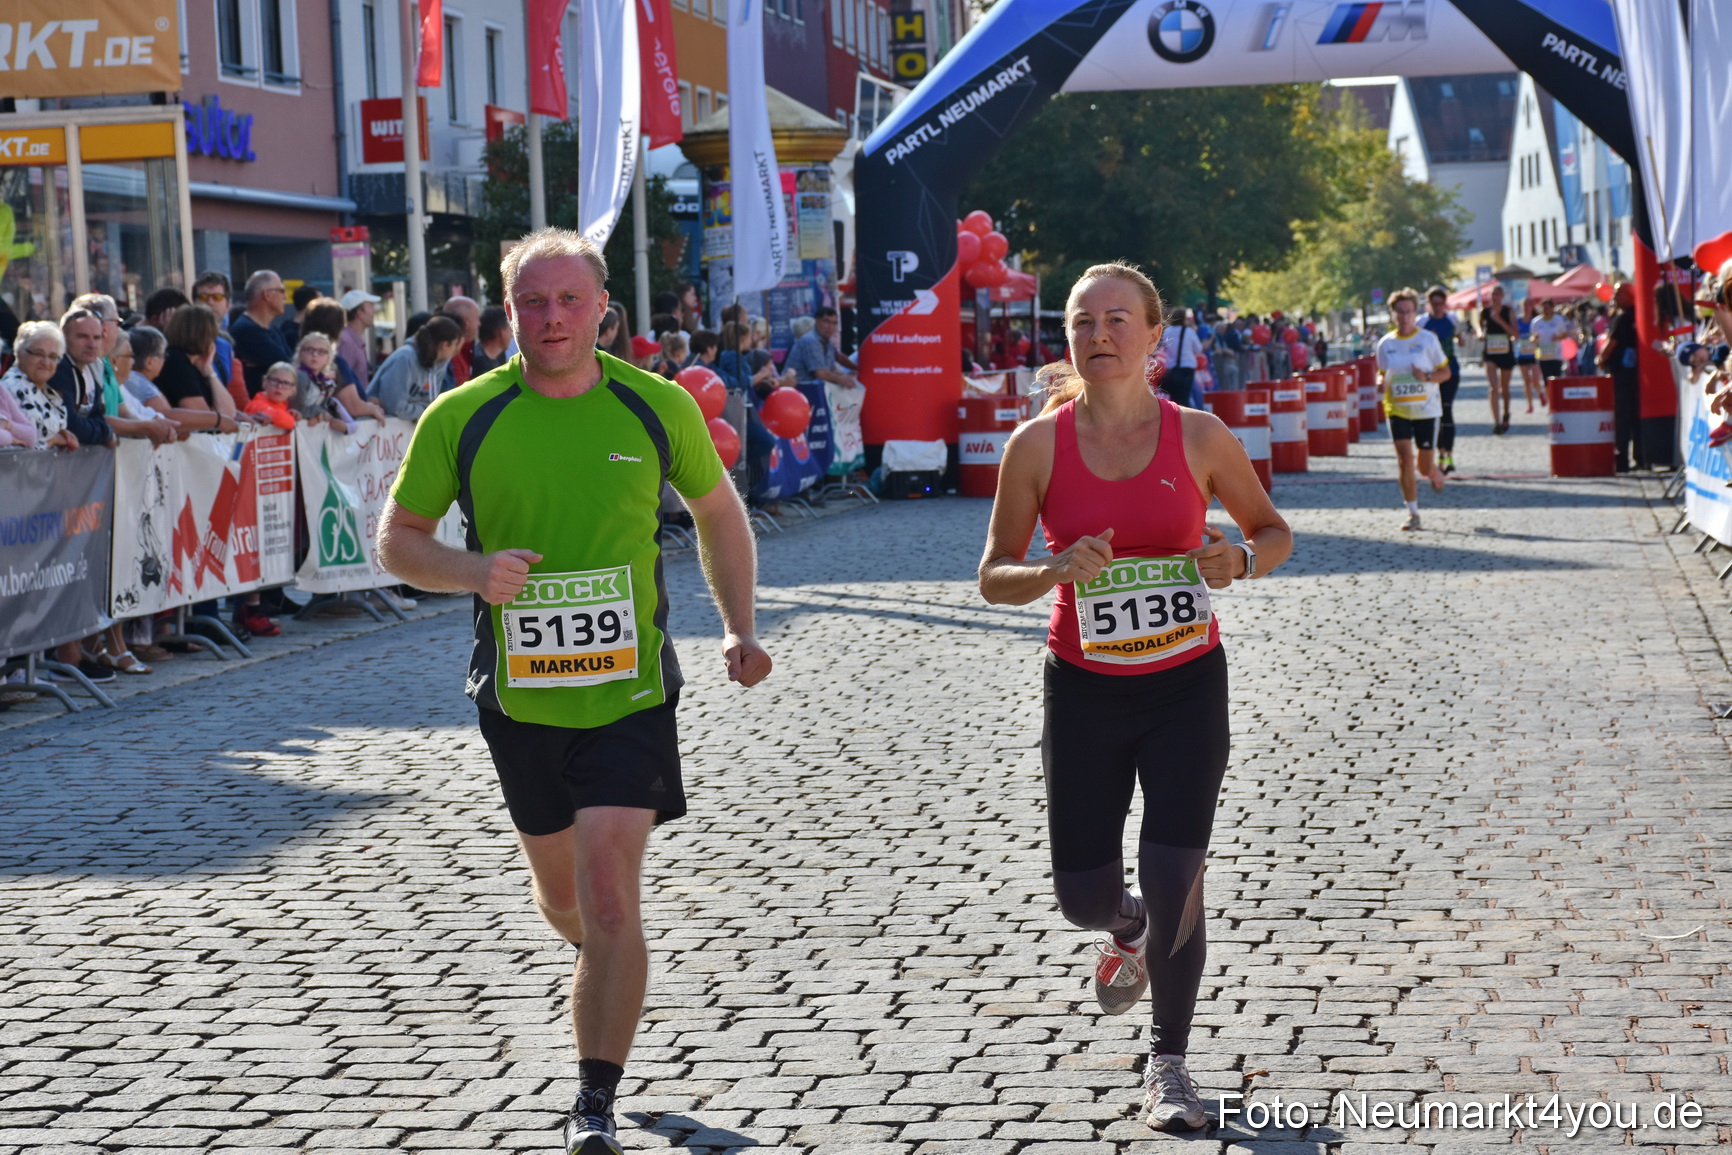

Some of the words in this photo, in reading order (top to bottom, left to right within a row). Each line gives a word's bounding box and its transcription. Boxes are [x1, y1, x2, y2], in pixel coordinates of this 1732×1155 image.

[1542, 32, 1598, 75] PARTL
[885, 122, 942, 166] PARTL
[938, 55, 1032, 129] NEUMARKT
[754, 151, 778, 230] NEUMARKT
[872, 333, 894, 344] BMW
[896, 333, 941, 346] Laufsport
[512, 572, 622, 606] BOCK
[1085, 559, 1192, 594] BOCK
[518, 609, 621, 648] 5139
[1092, 591, 1197, 635] 5138
[1096, 626, 1196, 653] MAGDALENA
[530, 655, 615, 675] MARKUS
